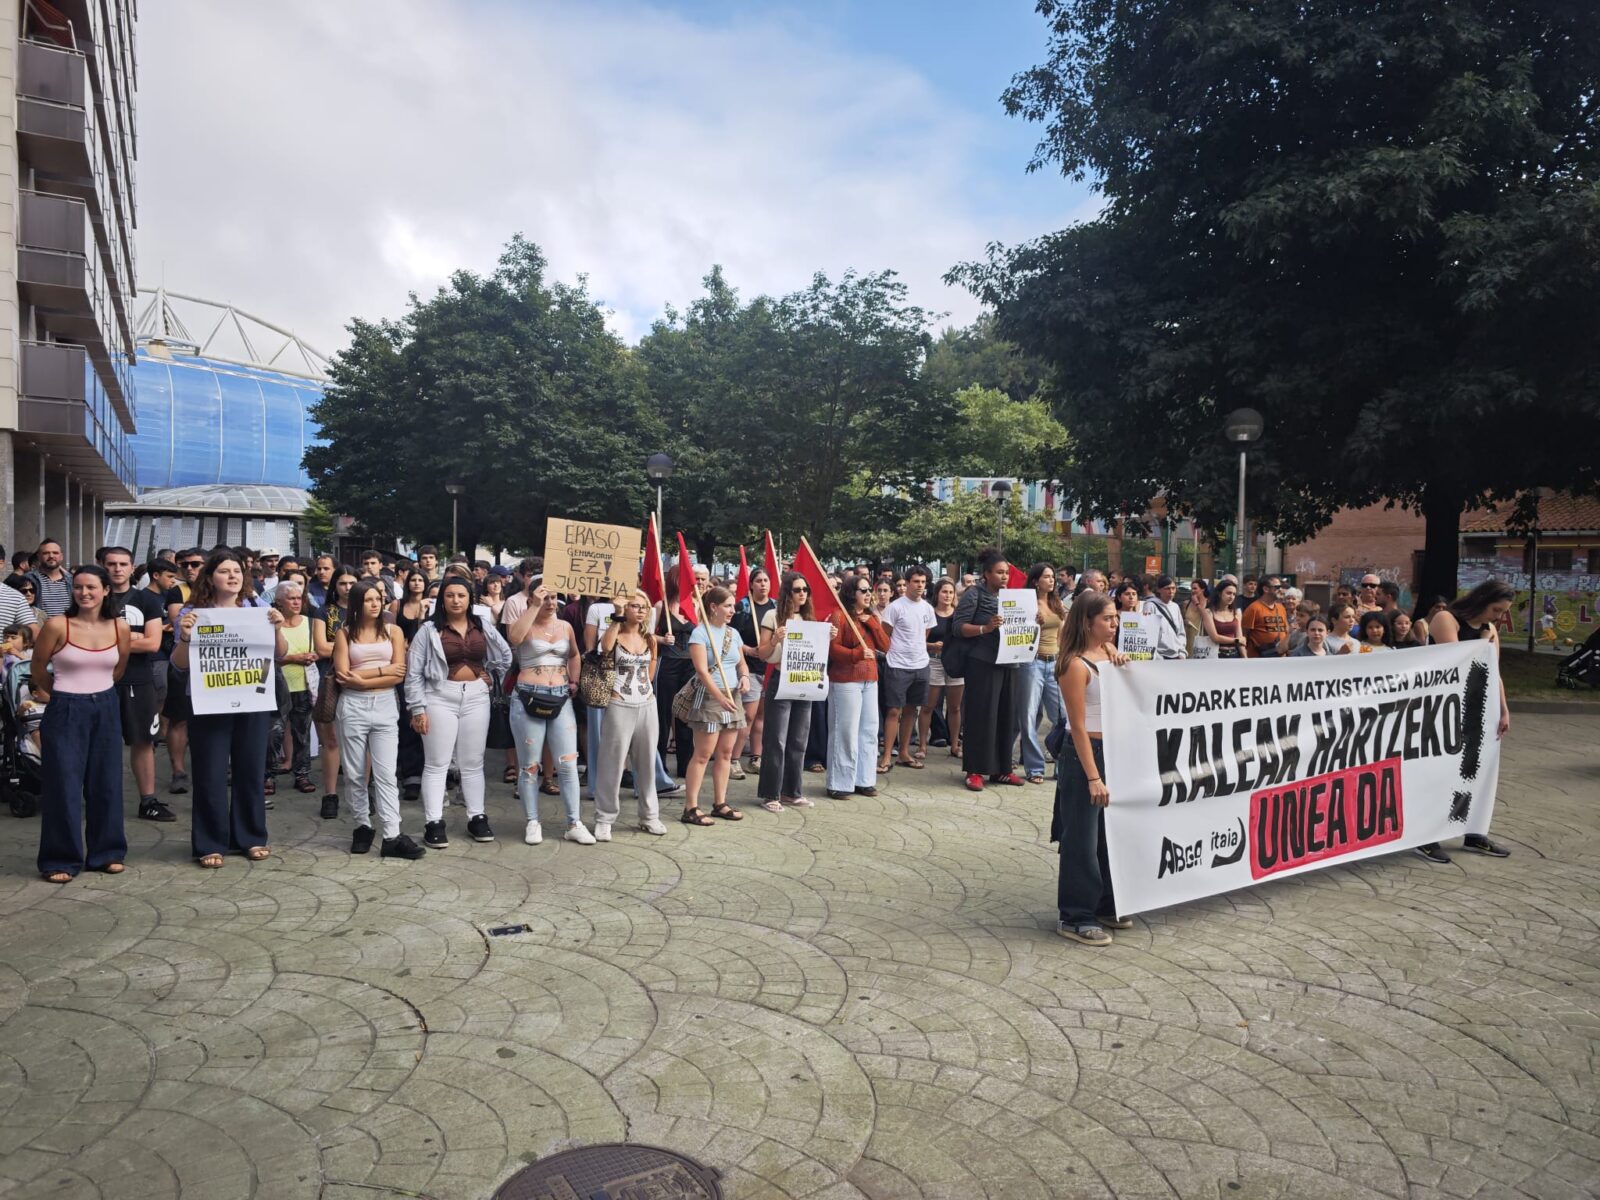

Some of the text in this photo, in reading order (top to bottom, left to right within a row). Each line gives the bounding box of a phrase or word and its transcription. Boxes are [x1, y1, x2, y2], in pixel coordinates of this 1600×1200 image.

[565, 524, 621, 550] ERASO
[554, 574, 628, 598] JUSTIZIA
[199, 646, 248, 659] KALEAK
[787, 651, 815, 662] KALEAK
[200, 658, 264, 673] HARTZEKO
[790, 671, 811, 683] UNEA
[207, 672, 241, 688] UNEA
[619, 666, 650, 695] 79
[1156, 667, 1461, 716] INDARKERIA MATXISTAREN AURKA
[1156, 693, 1464, 806] KALEAK HARTZEKO
[1257, 777, 1348, 869] UNEA
[1211, 828, 1238, 851] itaia
